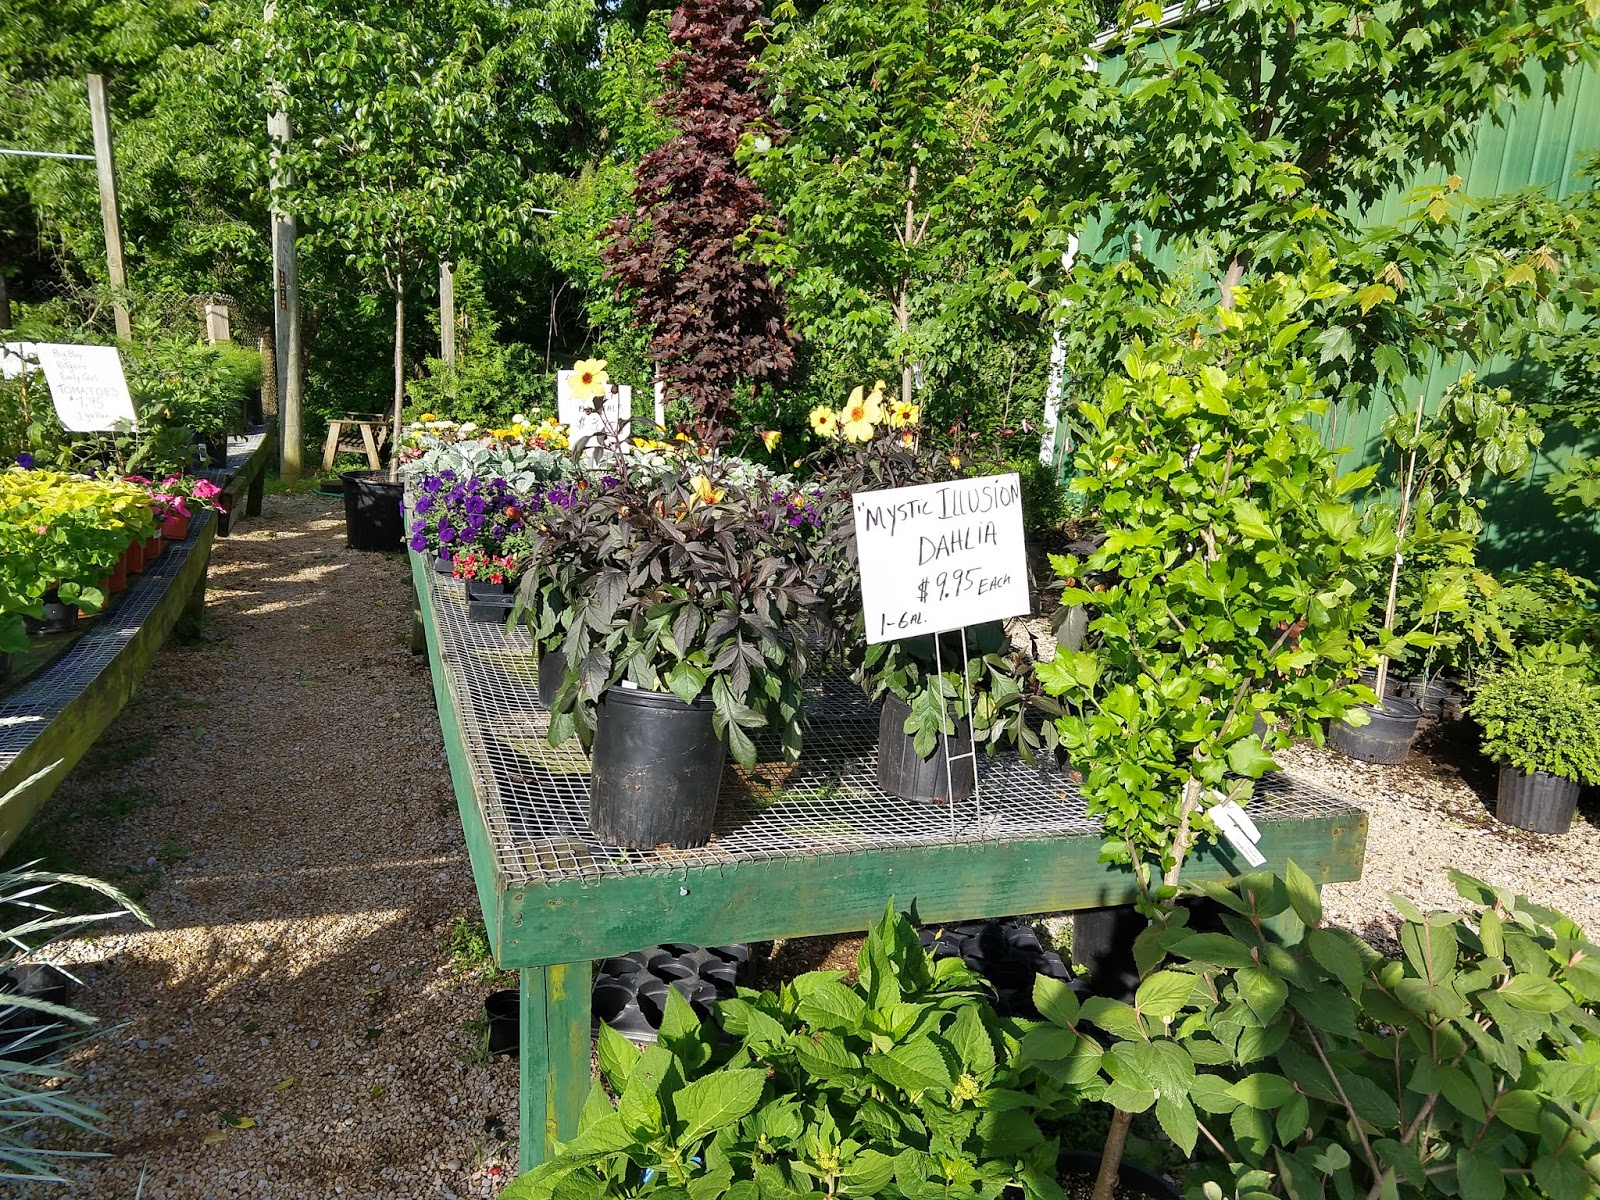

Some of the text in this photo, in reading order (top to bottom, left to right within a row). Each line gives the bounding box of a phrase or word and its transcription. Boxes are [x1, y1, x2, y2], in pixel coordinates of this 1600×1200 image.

[56, 384, 120, 397] TOMATOES
[936, 479, 1019, 520] ILLUSION
[918, 521, 997, 566] DAHLIA
[978, 573, 1011, 596] EACH
